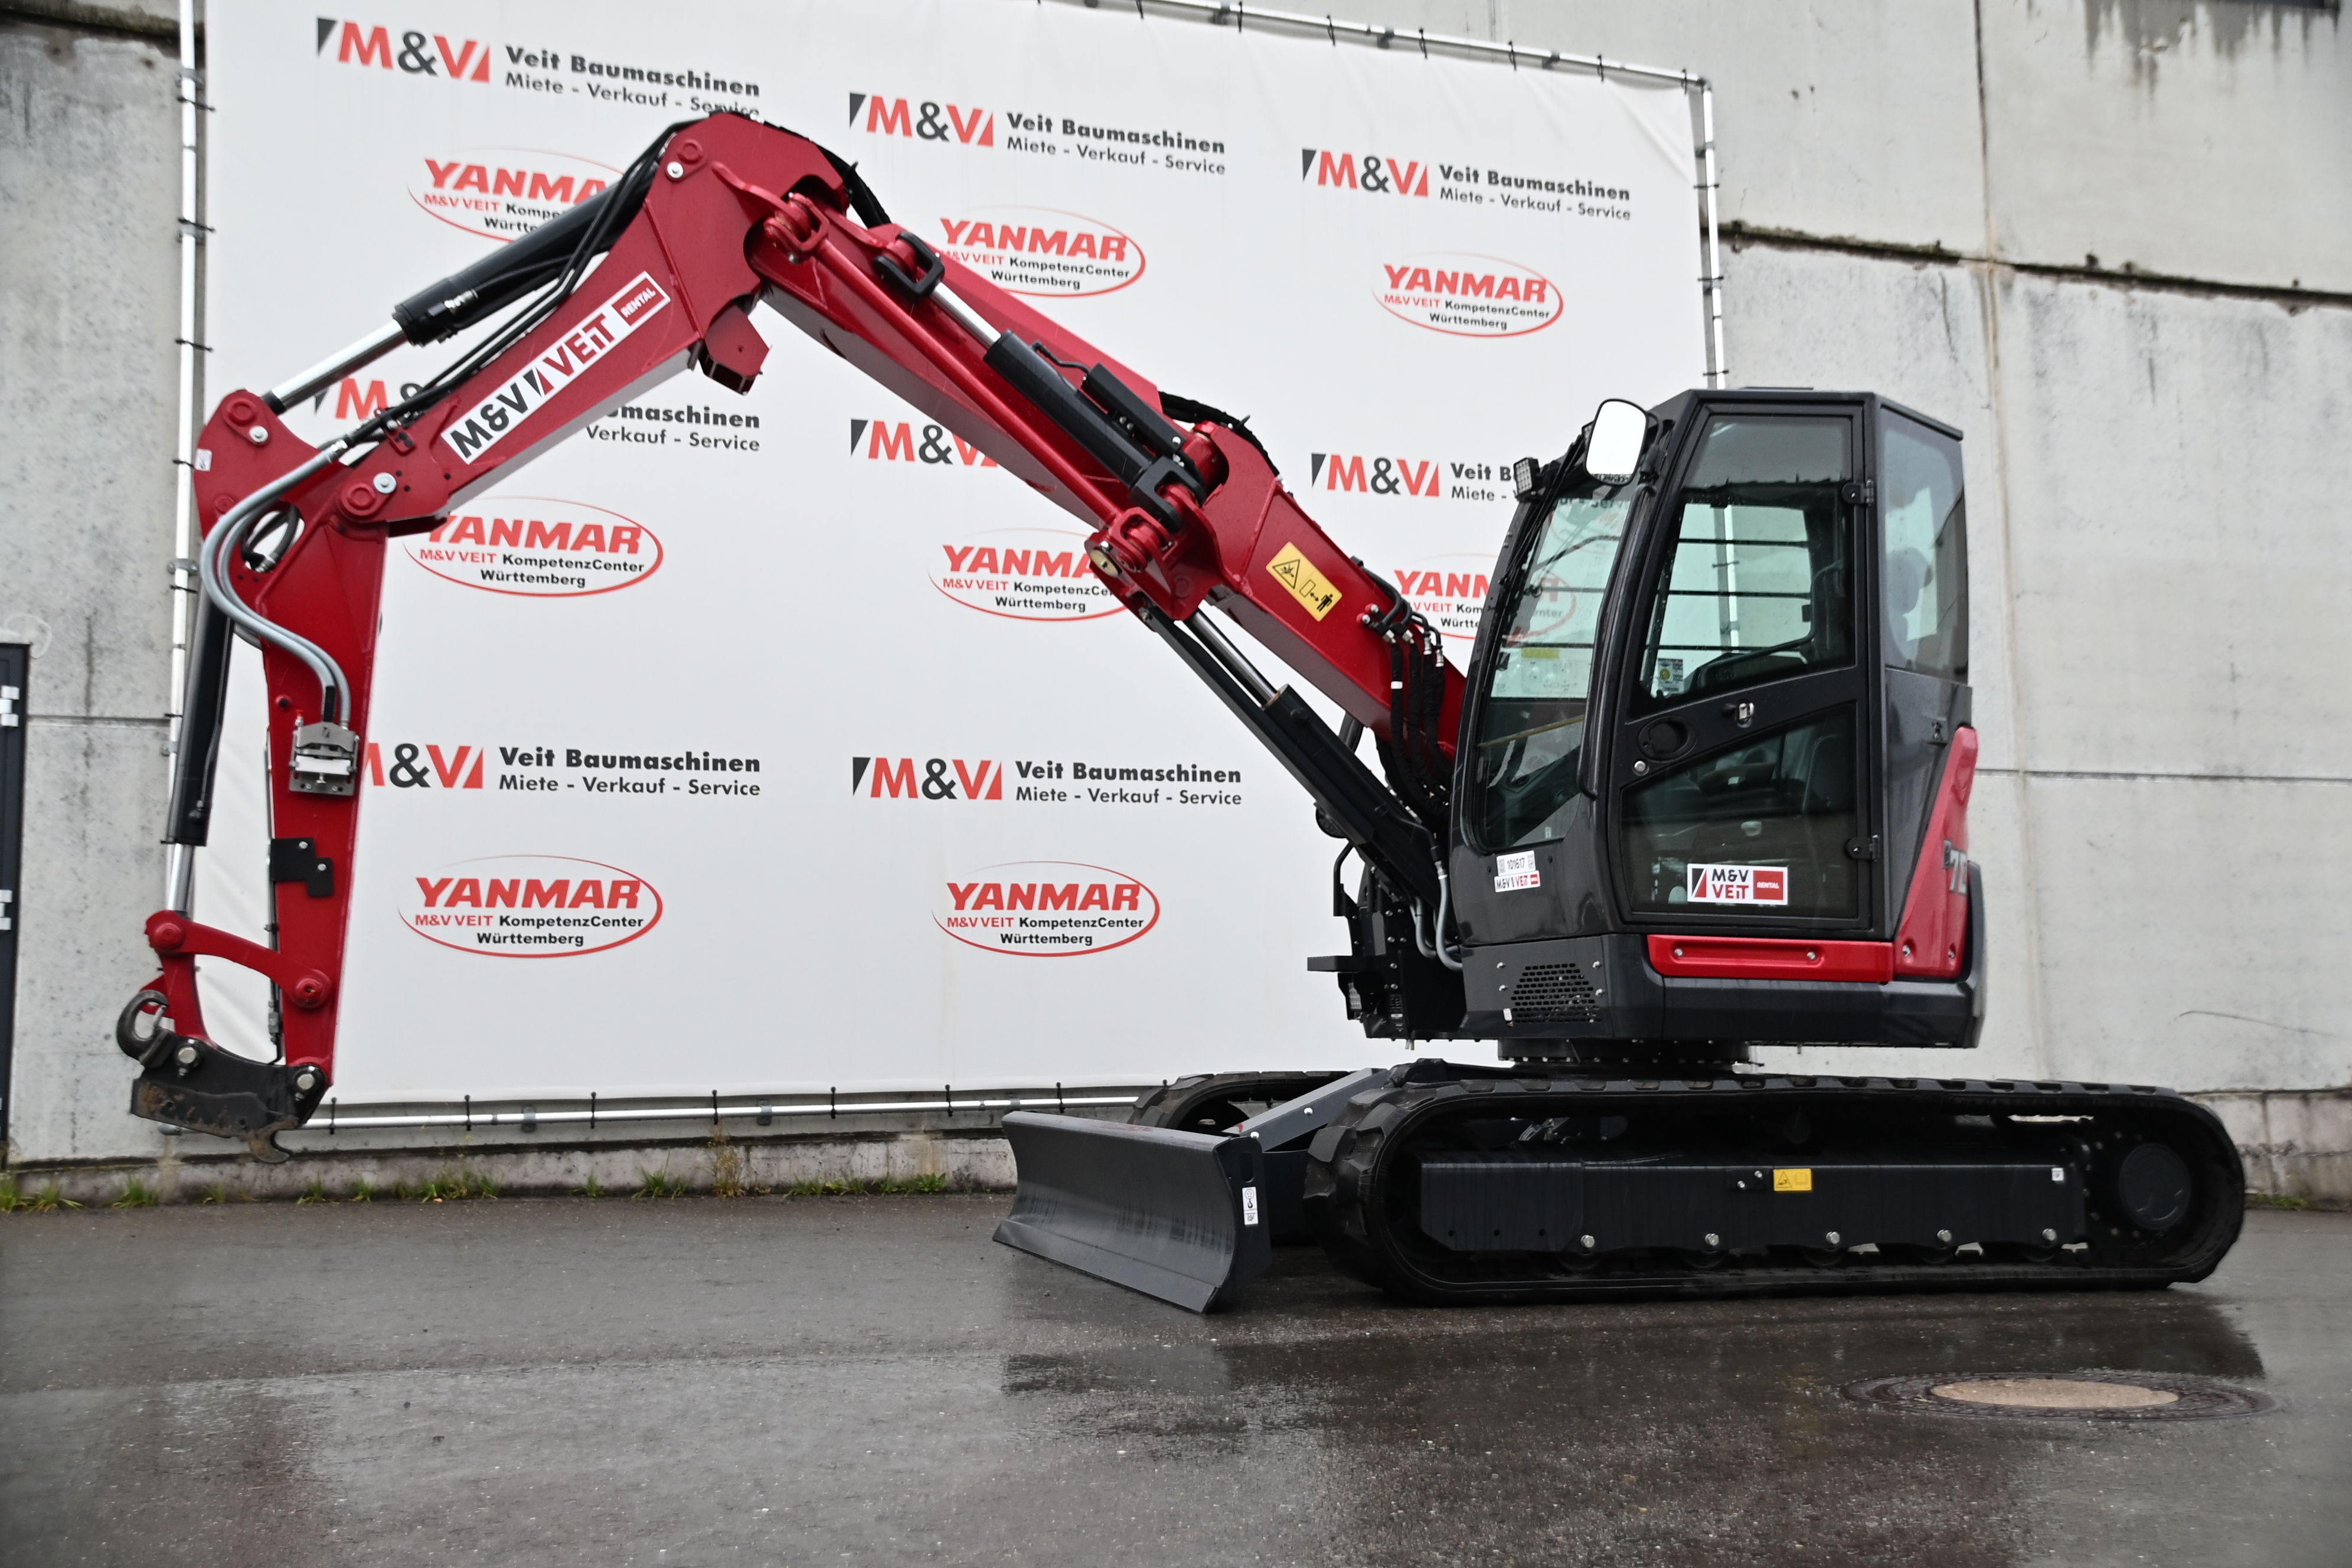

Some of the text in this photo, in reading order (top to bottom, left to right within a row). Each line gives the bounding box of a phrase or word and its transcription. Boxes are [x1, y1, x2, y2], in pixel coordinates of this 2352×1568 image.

[337, 21, 478, 80] M&V
[505, 44, 760, 97] Veit Baumaschinen
[505, 71, 564, 94] Miete
[587, 82, 667, 107] Verkauf
[866, 94, 984, 145] M&V
[1006, 112, 1225, 154] Veit Baumaschinen
[1007, 136, 1056, 155] Miete
[1076, 143, 1145, 165] Verkauf
[1165, 154, 1225, 175] Service
[424, 159, 607, 205] YANMA
[1317, 150, 1419, 195] M&V
[1439, 164, 1630, 202] Veit Baumaschinen
[424, 194, 459, 207] M&V
[463, 200, 499, 212] VEIT
[1440, 187, 1483, 204] Miete
[1500, 194, 1561, 213] Verkauf
[1578, 202, 1631, 220] Service
[484, 217, 537, 233] Württe
[940, 218, 1127, 262] YANMAR
[973, 253, 1004, 265] VEIT
[1010, 257, 1130, 278] KompetenzCenter
[991, 270, 1080, 290] Württemberg
[1384, 264, 1547, 303] YANMAR
[1384, 295, 1550, 318] M&V VEIT KompetenzCenter
[1429, 312, 1507, 331] Württemberg
[450, 382, 528, 459] M&V
[620, 287, 656, 318] RENTAL
[606, 405, 760, 429] maschinen
[586, 425, 667, 445] Verkauf
[689, 432, 760, 452] Service
[1327, 454, 1430, 496] M&V
[1450, 462, 1492, 481] Veit
[1451, 485, 1495, 501] Miete
[420, 549, 645, 573] M&V VEIT KompetenzCenter
[943, 544, 1098, 579] YANMA
[480, 569, 586, 589] Württemberg
[943, 578, 1112, 596] M&V VEIT KompetenzCe
[995, 596, 1086, 613] Württemberg
[1423, 602, 1452, 612] VEIT
[498, 746, 760, 773] Veit Baumaschinen
[1015, 760, 1241, 783] Veit Baumaschinen
[498, 774, 559, 792] Miete
[582, 776, 666, 794] Verkauf
[688, 779, 761, 796] Service
[870, 757, 992, 801] M&V
[1015, 786, 1067, 802] Miete
[1087, 787, 1160, 803] Verkauf
[1179, 789, 1242, 805] Service
[1711, 868, 1749, 882] M&V
[416, 877, 641, 909] YANMAR
[946, 883, 1141, 911] YANMAR
[415, 914, 644, 930] M&V VEIT KompetenzCenter
[947, 917, 1145, 930] M&V VEIT KompetenzCenter
[476, 932, 584, 948] Württemberg
[999, 933, 1093, 947] Württemberg
